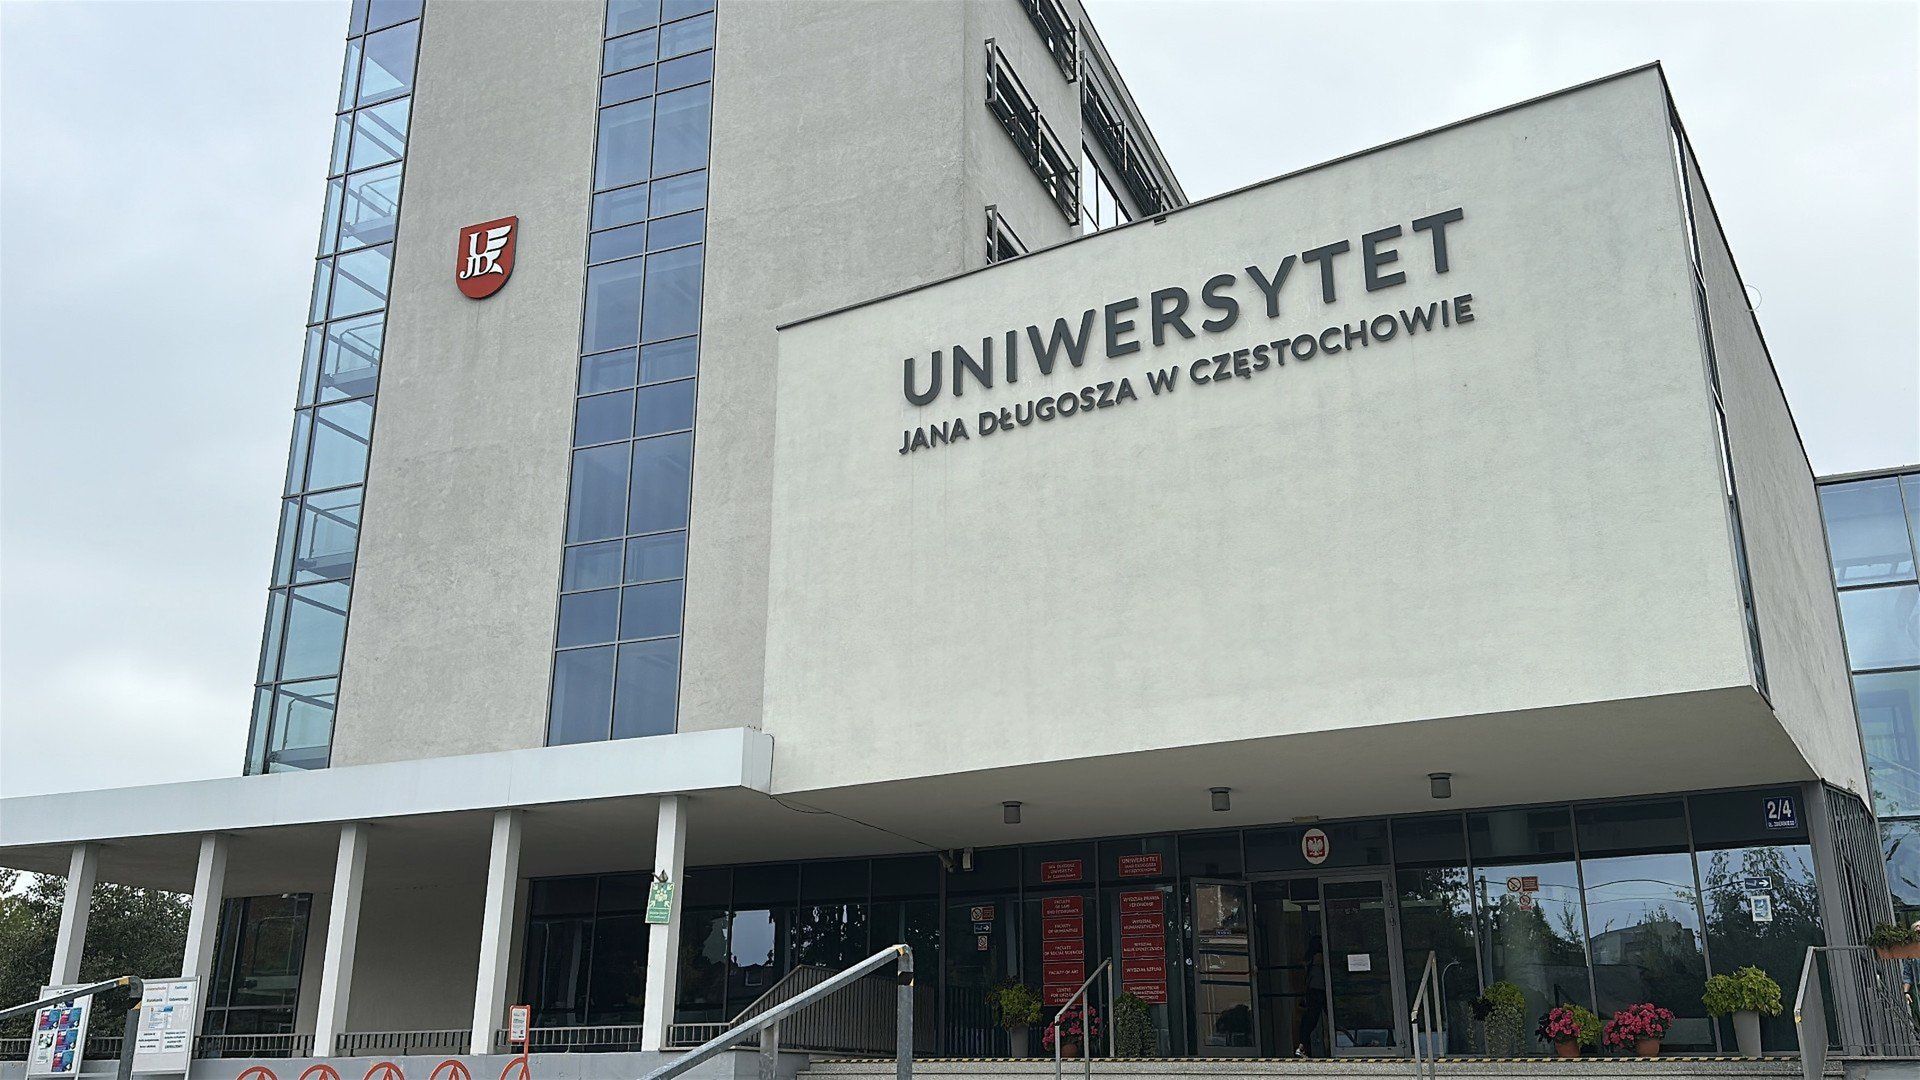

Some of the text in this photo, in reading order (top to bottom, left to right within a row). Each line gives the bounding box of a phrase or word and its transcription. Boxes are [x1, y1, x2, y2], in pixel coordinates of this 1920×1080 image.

[899, 293, 1475, 455] JANA DŁUGOSZA W CZĘSTOCHOWIE
[903, 207, 1464, 407] UNIWERSYTET
[1767, 799, 1791, 820] 2/4
